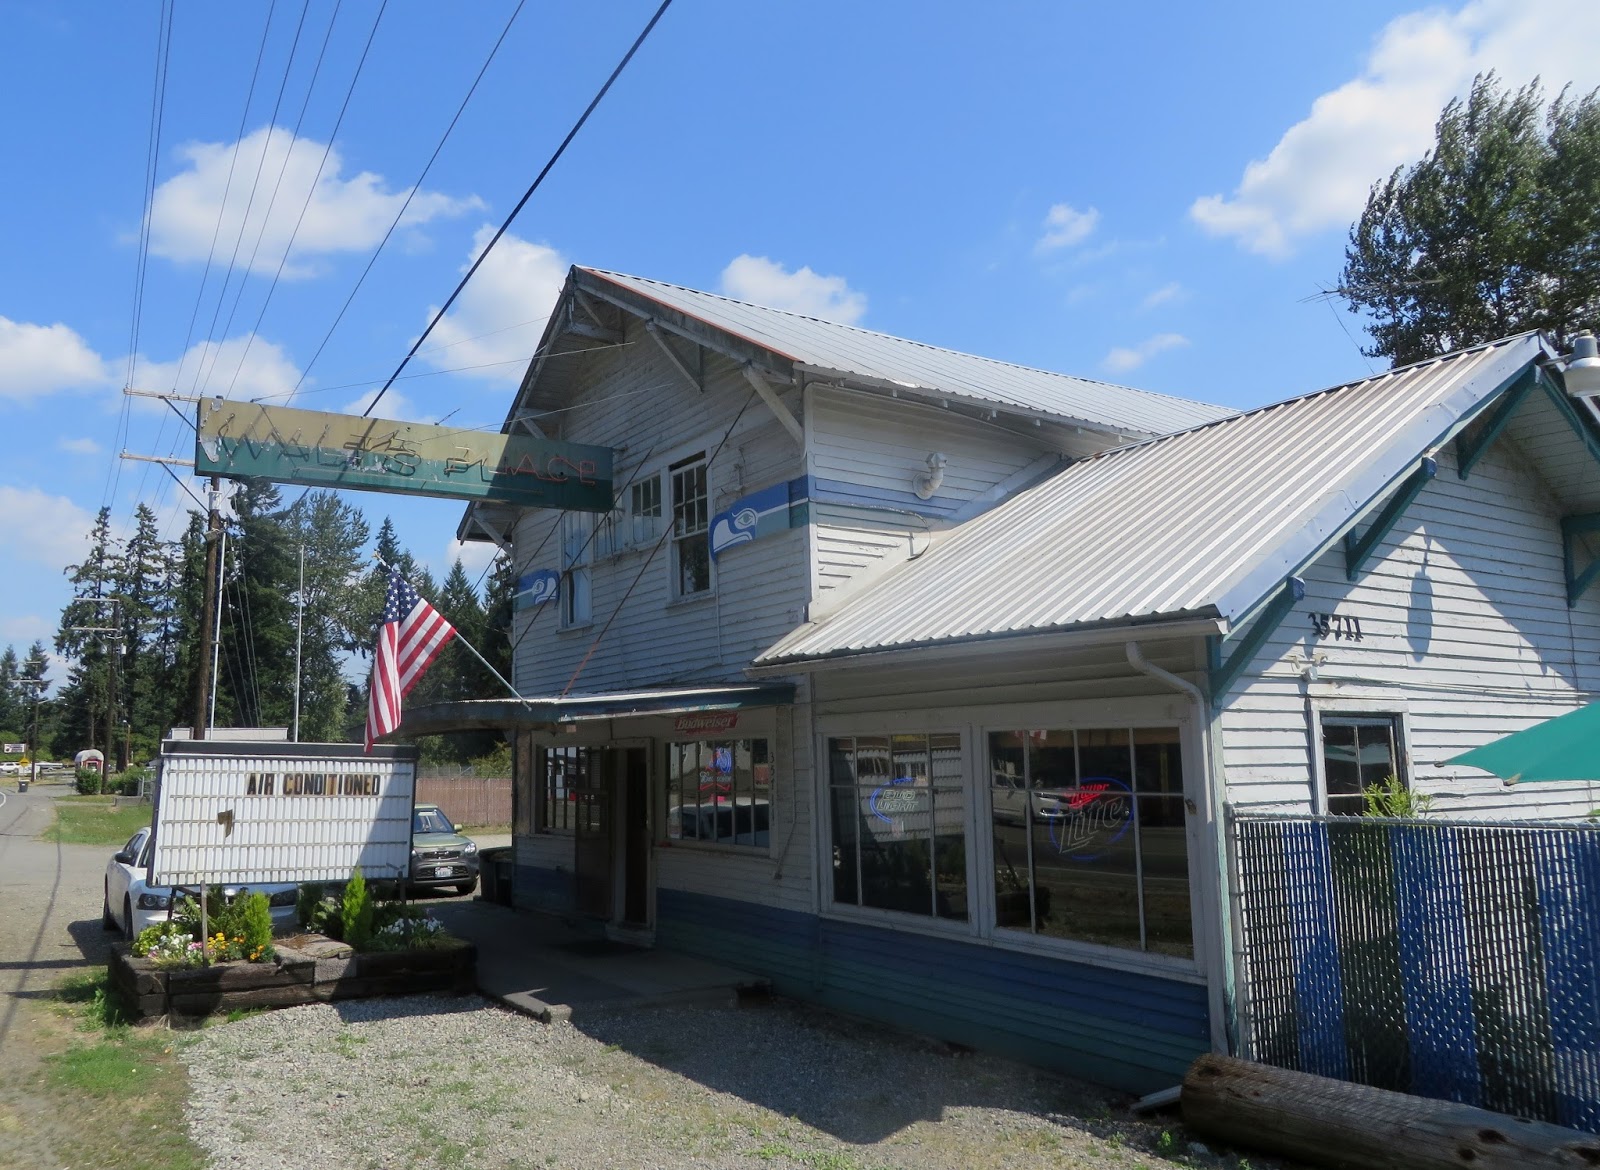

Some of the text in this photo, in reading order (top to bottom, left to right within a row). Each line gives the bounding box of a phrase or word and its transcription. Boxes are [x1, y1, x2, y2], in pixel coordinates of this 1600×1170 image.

[444, 444, 597, 487] PLACE
[1308, 612, 1362, 642] 35711
[677, 716, 733, 730] Budweiser
[247, 773, 380, 796] AIR CONDITIONED
[883, 789, 915, 800] BUD
[877, 800, 918, 811] LIGHT
[1058, 796, 1124, 854] Lite
